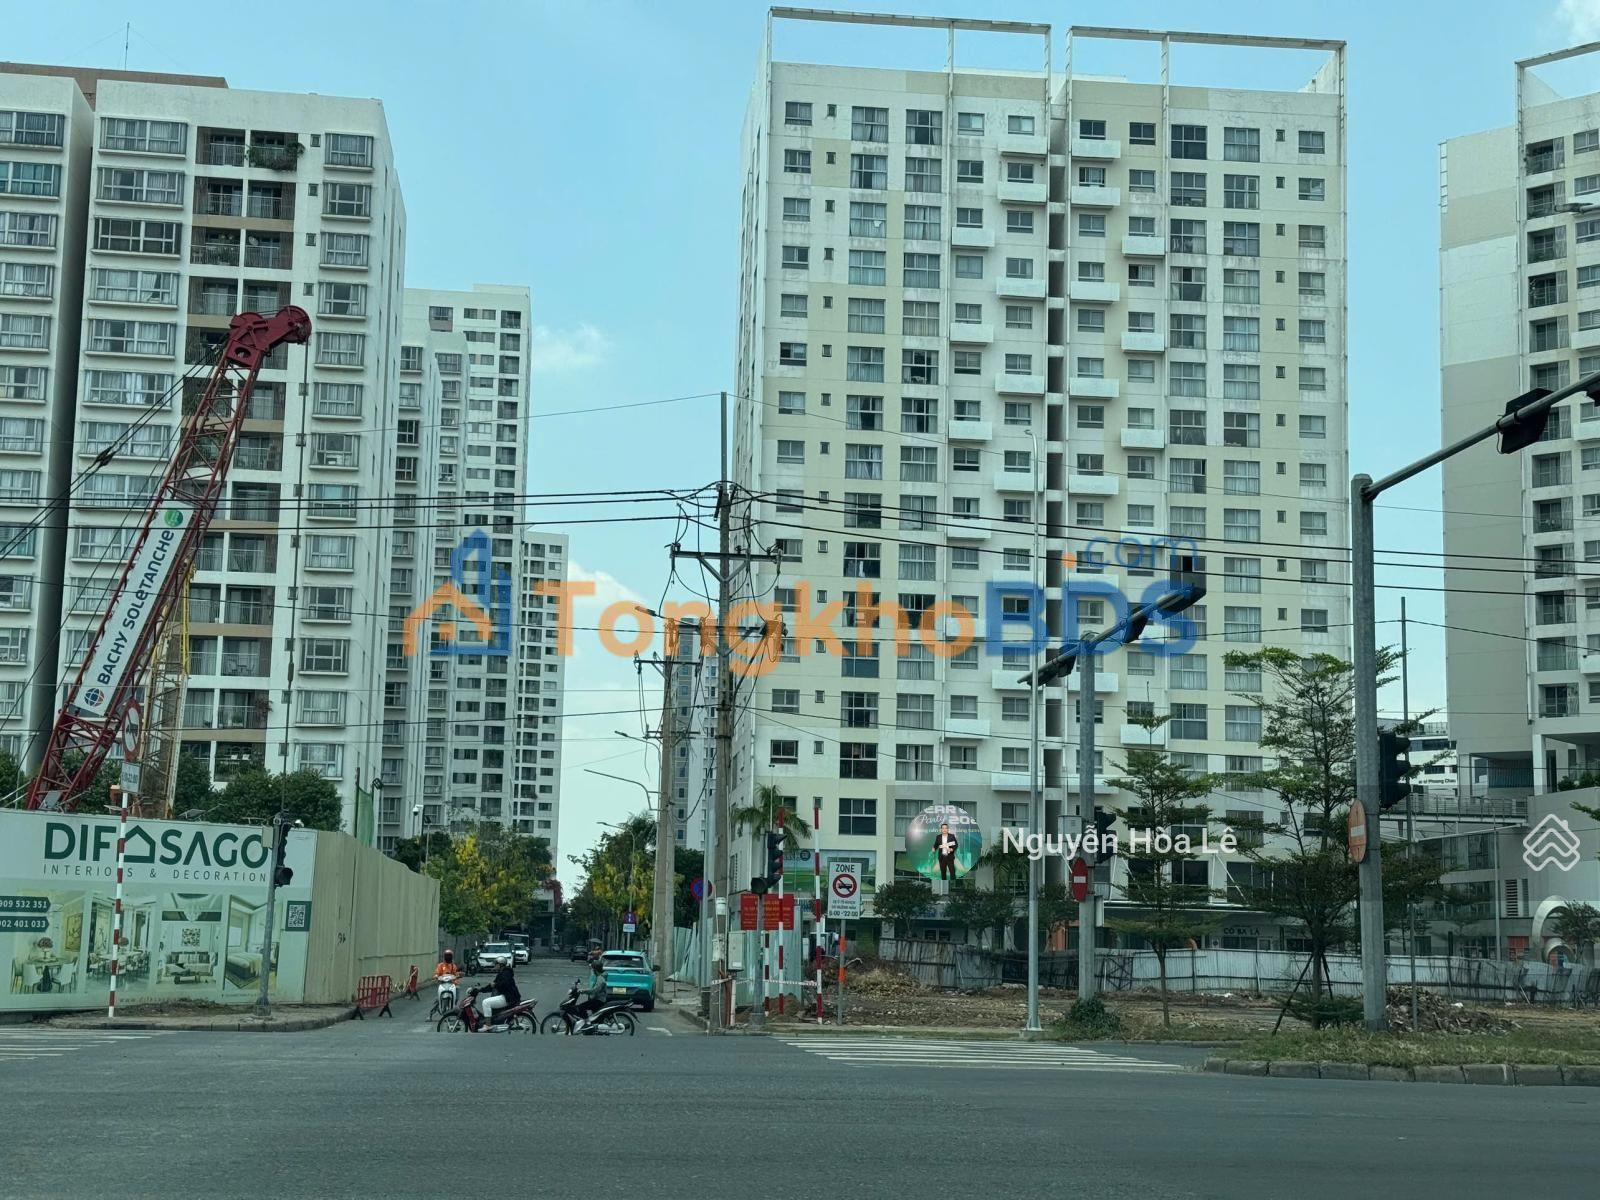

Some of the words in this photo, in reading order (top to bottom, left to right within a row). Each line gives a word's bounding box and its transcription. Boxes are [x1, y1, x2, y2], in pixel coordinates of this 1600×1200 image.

[97, 631, 128, 685] BACHY
[43, 864, 133, 878] INTERIOS
[149, 868, 157, 878] &
[173, 869, 266, 882] DECORATION
[835, 863, 855, 873] ZONE
[15, 900, 31, 908] 532
[32, 901, 47, 909] 351
[14, 920, 29, 928] 401
[31, 920, 46, 928] 033
